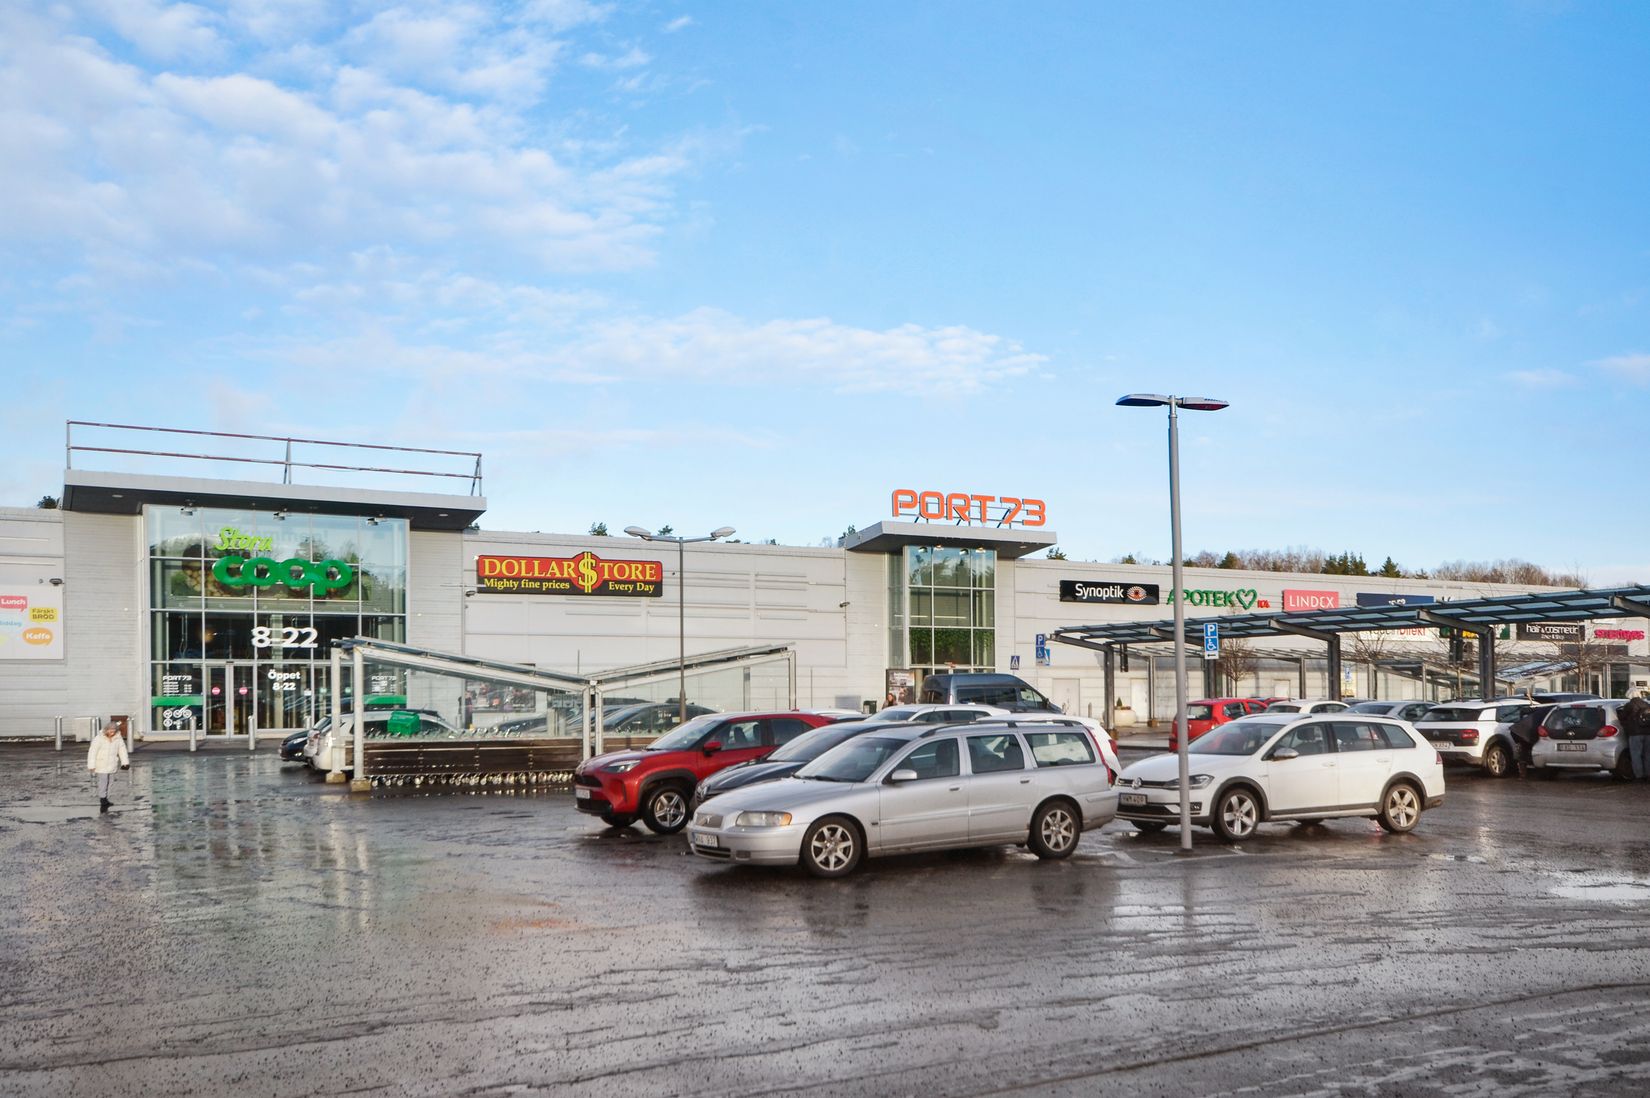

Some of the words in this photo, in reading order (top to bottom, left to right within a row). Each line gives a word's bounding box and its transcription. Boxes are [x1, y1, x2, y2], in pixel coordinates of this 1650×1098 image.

[215, 526, 273, 551] Stora
[212, 555, 353, 596] coop
[483, 578, 518, 590] Mighty
[521, 579, 540, 588] fine
[542, 580, 570, 591] prices
[608, 581, 634, 592] Every
[636, 582, 655, 594] Day
[1075, 583, 1124, 601] Synoptik
[1289, 595, 1335, 609] LINDEX
[251, 626, 318, 648] 8-22
[267, 669, 301, 682] Öppet
[272, 682, 297, 691] 8-22
